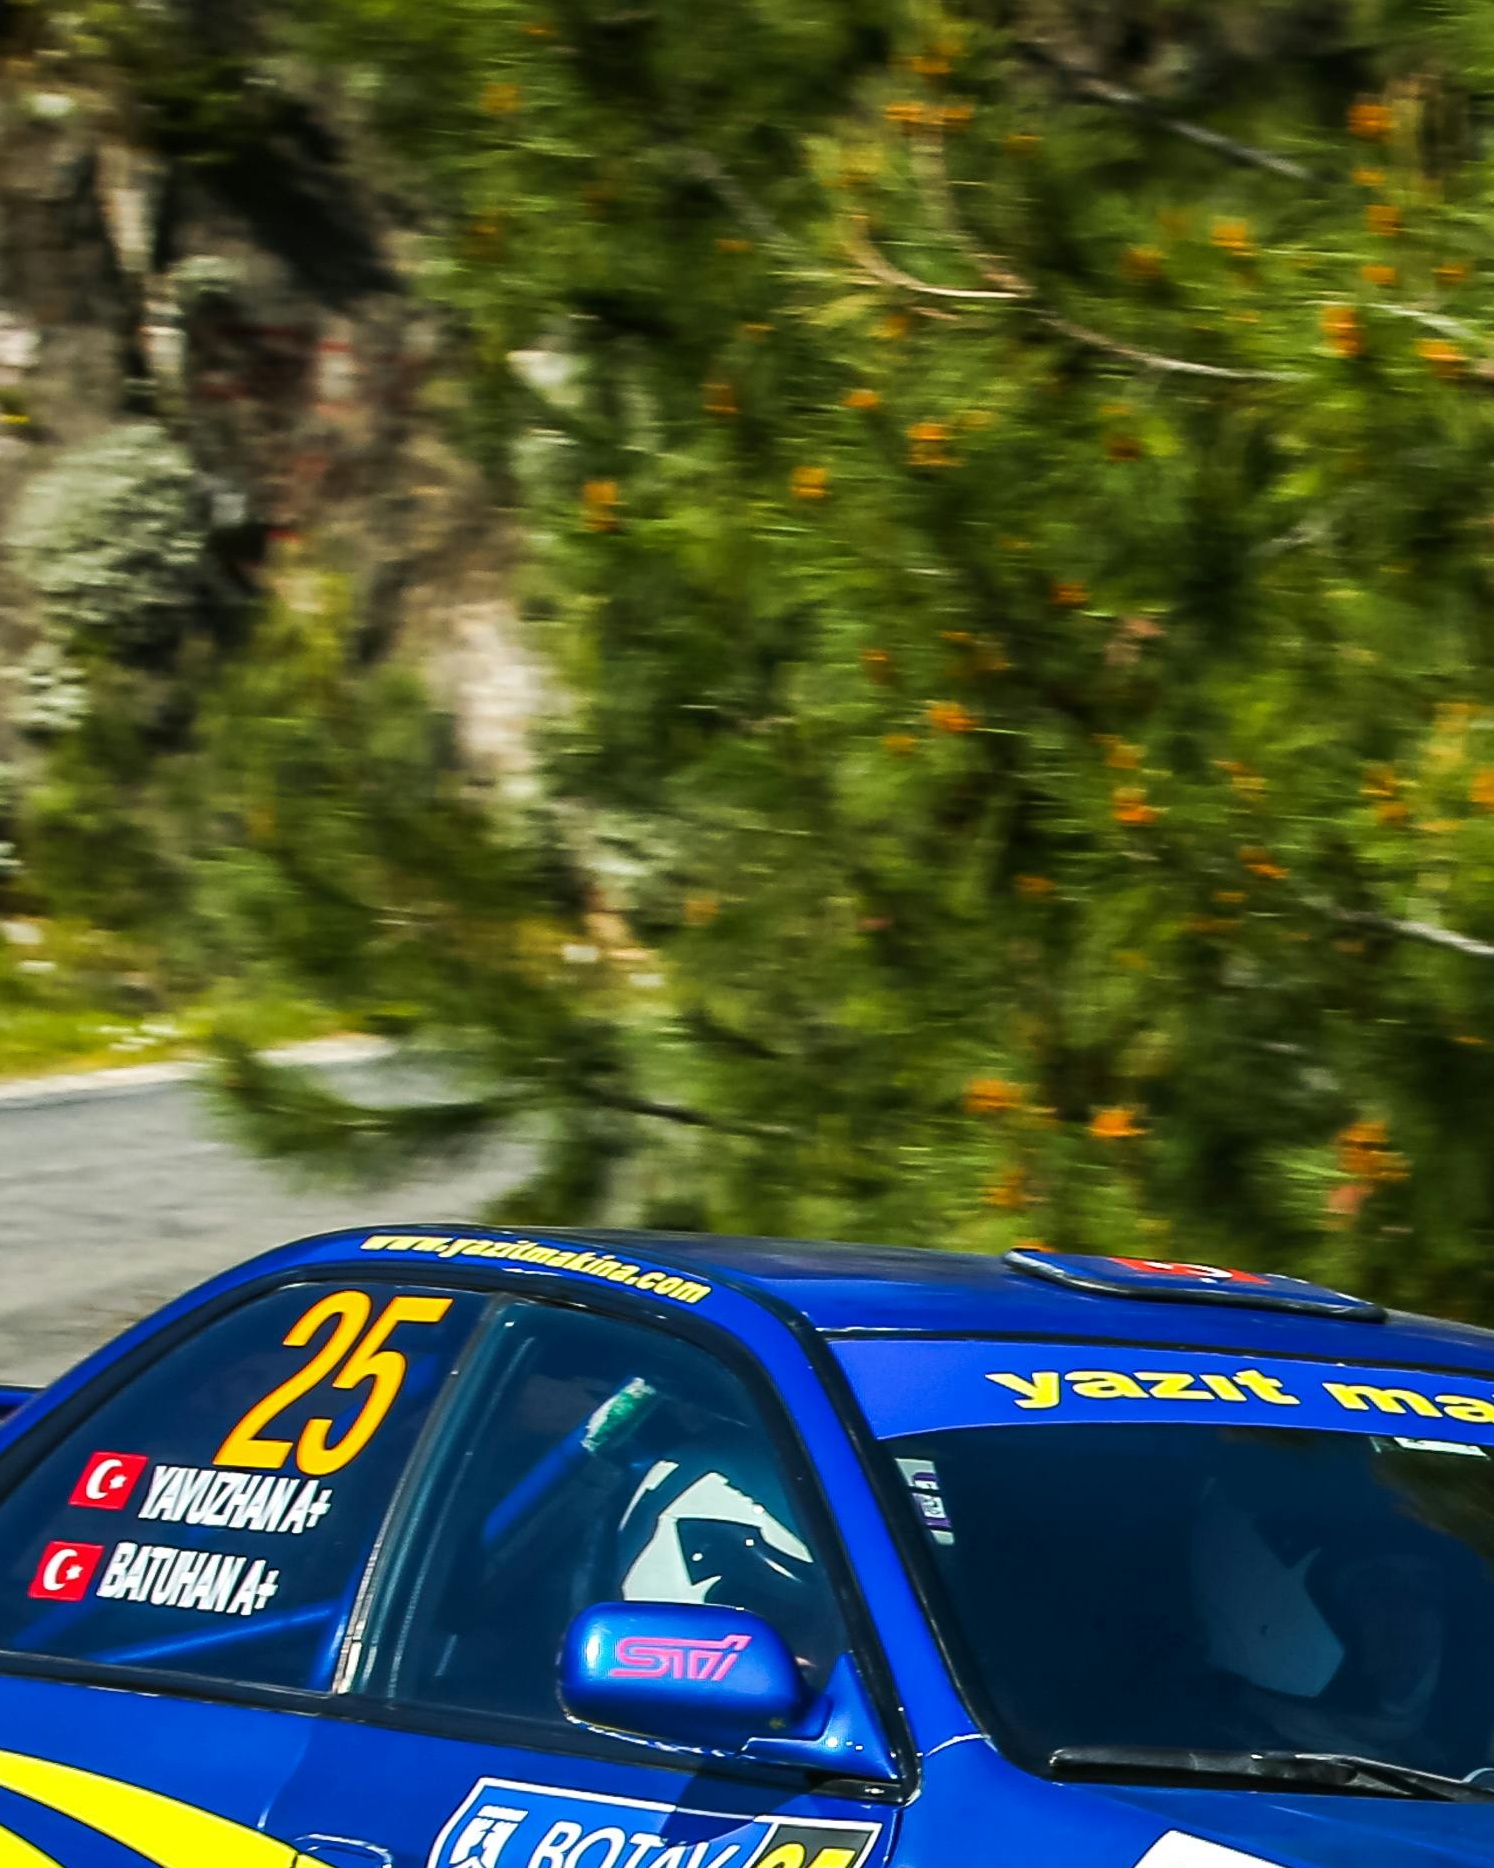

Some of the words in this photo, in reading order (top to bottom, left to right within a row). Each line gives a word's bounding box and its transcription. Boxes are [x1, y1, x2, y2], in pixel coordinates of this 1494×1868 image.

[359, 1234, 712, 1304] www.yazitmakina.com
[211, 1289, 454, 1476] 25
[137, 1464, 301, 1533] YAVUZHAN
[96, 1541, 247, 1612] BATUHAN
